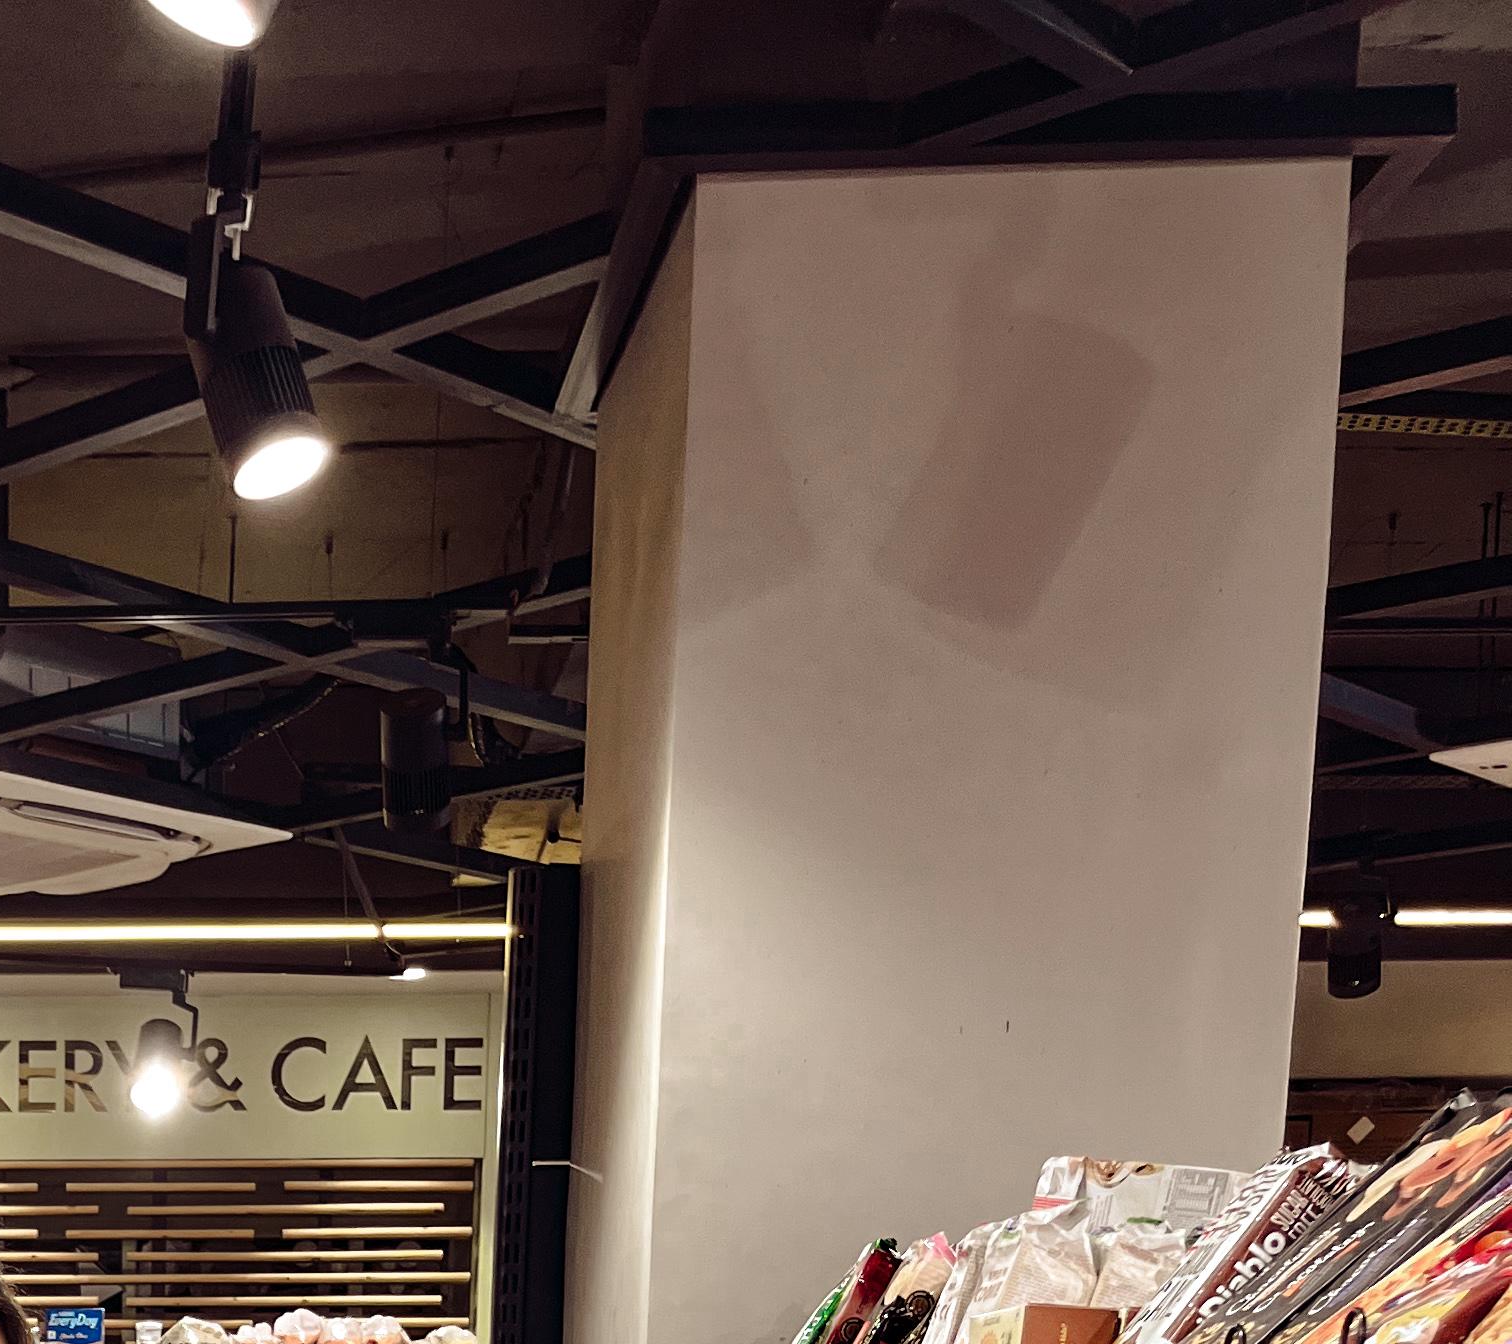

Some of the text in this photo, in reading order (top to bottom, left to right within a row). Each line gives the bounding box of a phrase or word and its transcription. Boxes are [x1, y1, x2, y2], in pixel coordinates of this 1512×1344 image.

[193, 1037, 247, 1111] &
[272, 1037, 483, 1111] CAFE
[1271, 1190, 1310, 1228] SUGAR
[49, 1313, 99, 1329] EveryDay
